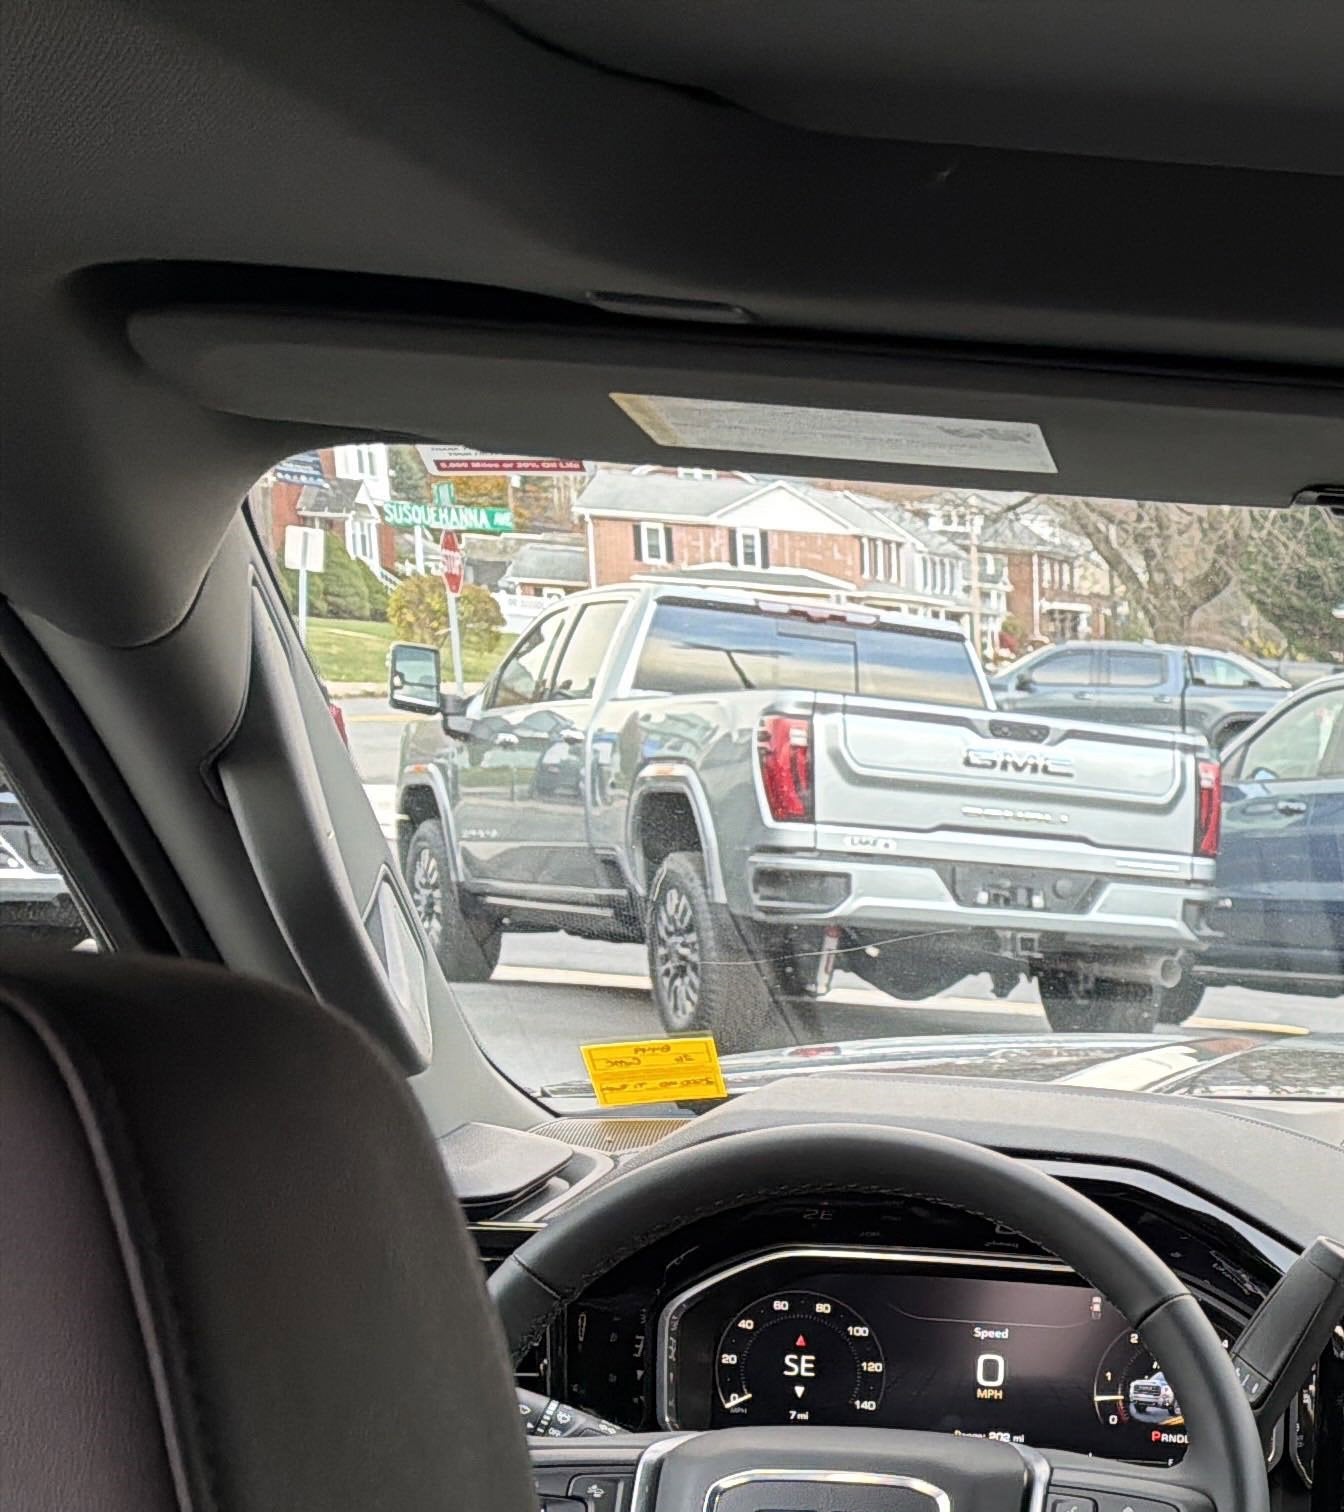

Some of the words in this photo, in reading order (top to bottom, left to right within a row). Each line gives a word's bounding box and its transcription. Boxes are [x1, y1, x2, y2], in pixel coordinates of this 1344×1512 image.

[383, 502, 492, 529] SUSQUEHANNA
[962, 748, 1075, 778] GMC
[773, 1301, 789, 1311] 60
[815, 1303, 832, 1314] 80
[737, 1319, 755, 1330] 40
[847, 1326, 869, 1337] 100
[973, 1327, 1009, 1340] Speed
[1130, 1333, 1139, 1344] 2
[721, 1354, 738, 1365] 20
[783, 1354, 816, 1377] SE
[861, 1361, 883, 1373] 120
[977, 1353, 1005, 1387] 0
[1105, 1371, 1112, 1381] 1
[976, 1387, 1003, 1400] MPH
[854, 1400, 877, 1411] 140
[789, 1410, 796, 1420] 7
[797, 1410, 809, 1420] mi
[1108, 1415, 1118, 1425] 0
